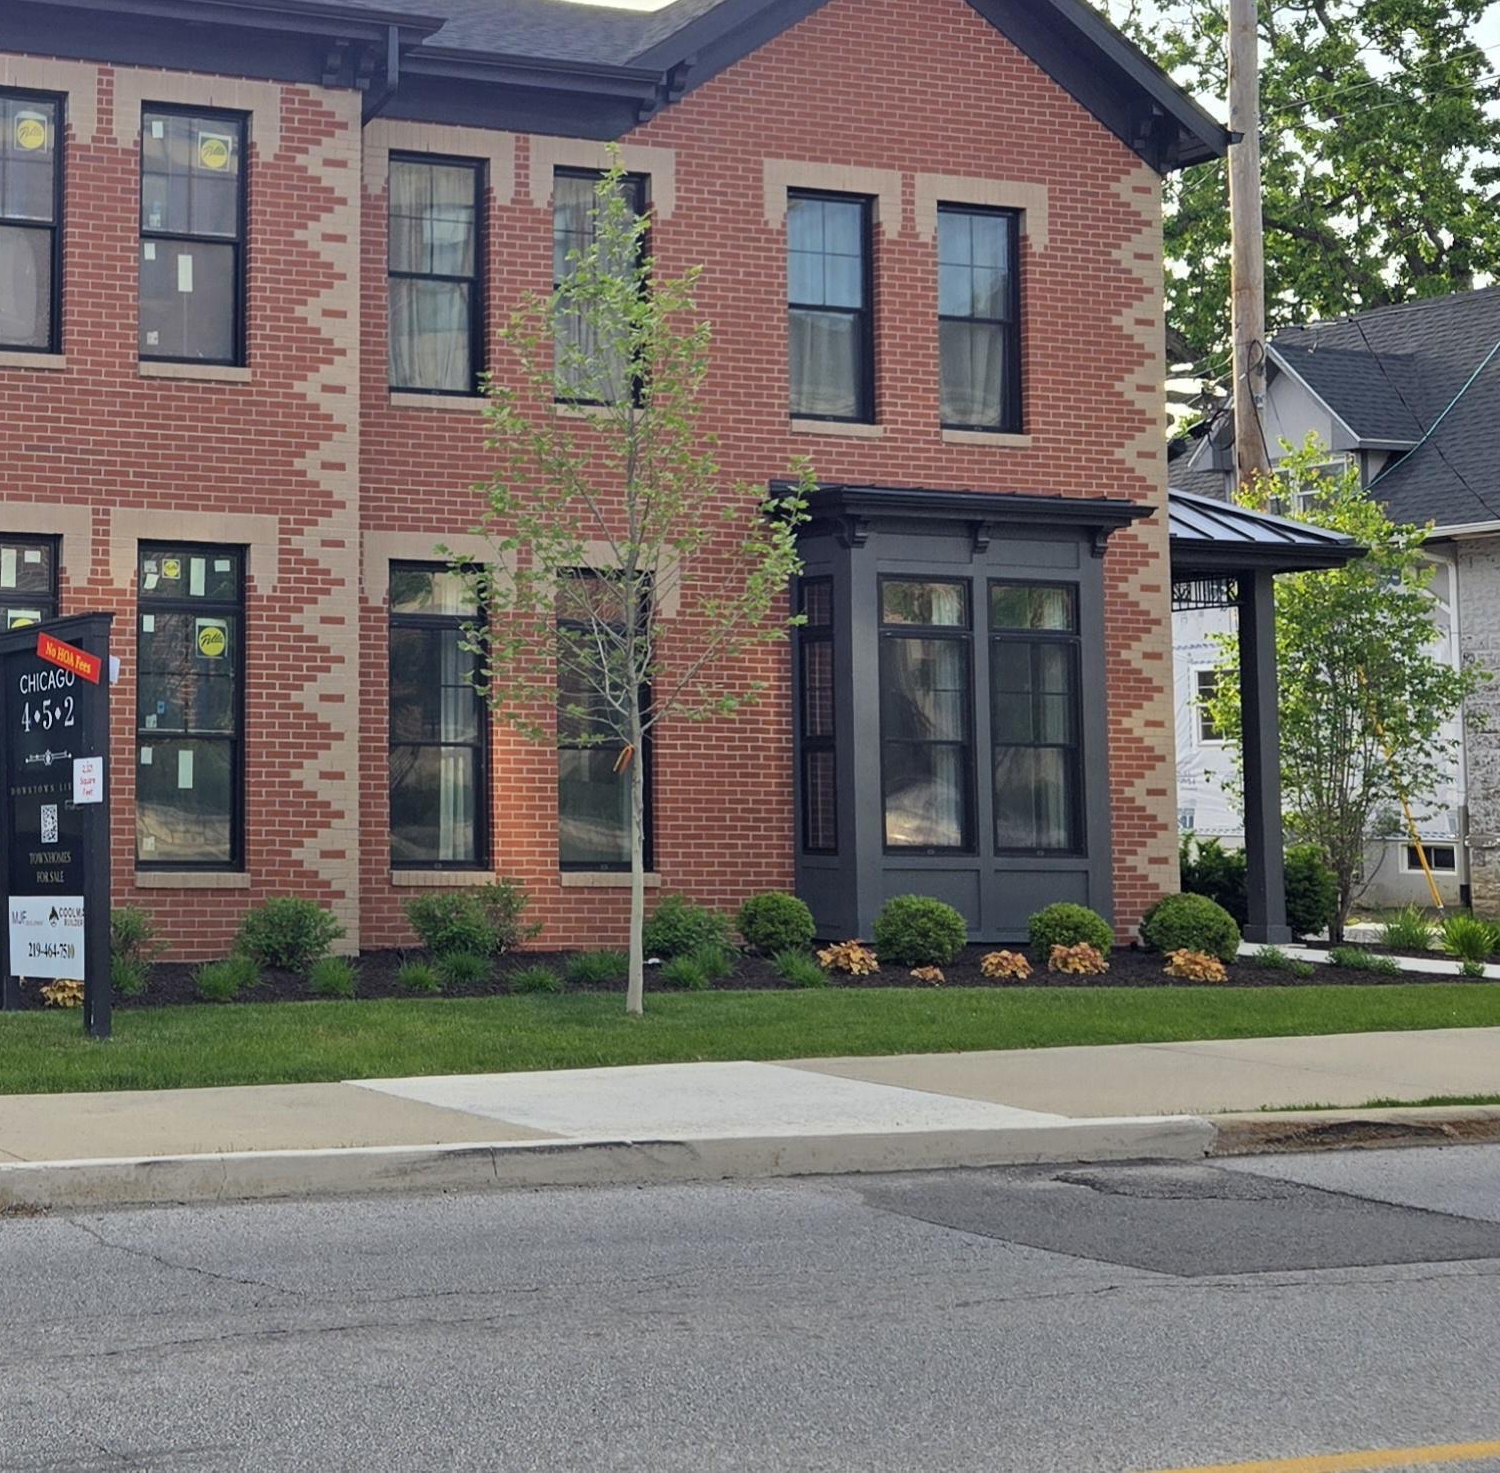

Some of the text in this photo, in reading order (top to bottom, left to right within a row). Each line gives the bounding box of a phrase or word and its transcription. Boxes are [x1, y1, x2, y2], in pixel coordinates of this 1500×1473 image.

[200, 633, 224, 647] Pella
[45, 641, 92, 674] No HOA Fees
[19, 668, 75, 694] CHICAGO
[28, 850, 72, 865] TOWNHOMES
[36, 870, 65, 883] FOR SALE
[28, 942, 75, 959] 219-464-7510
